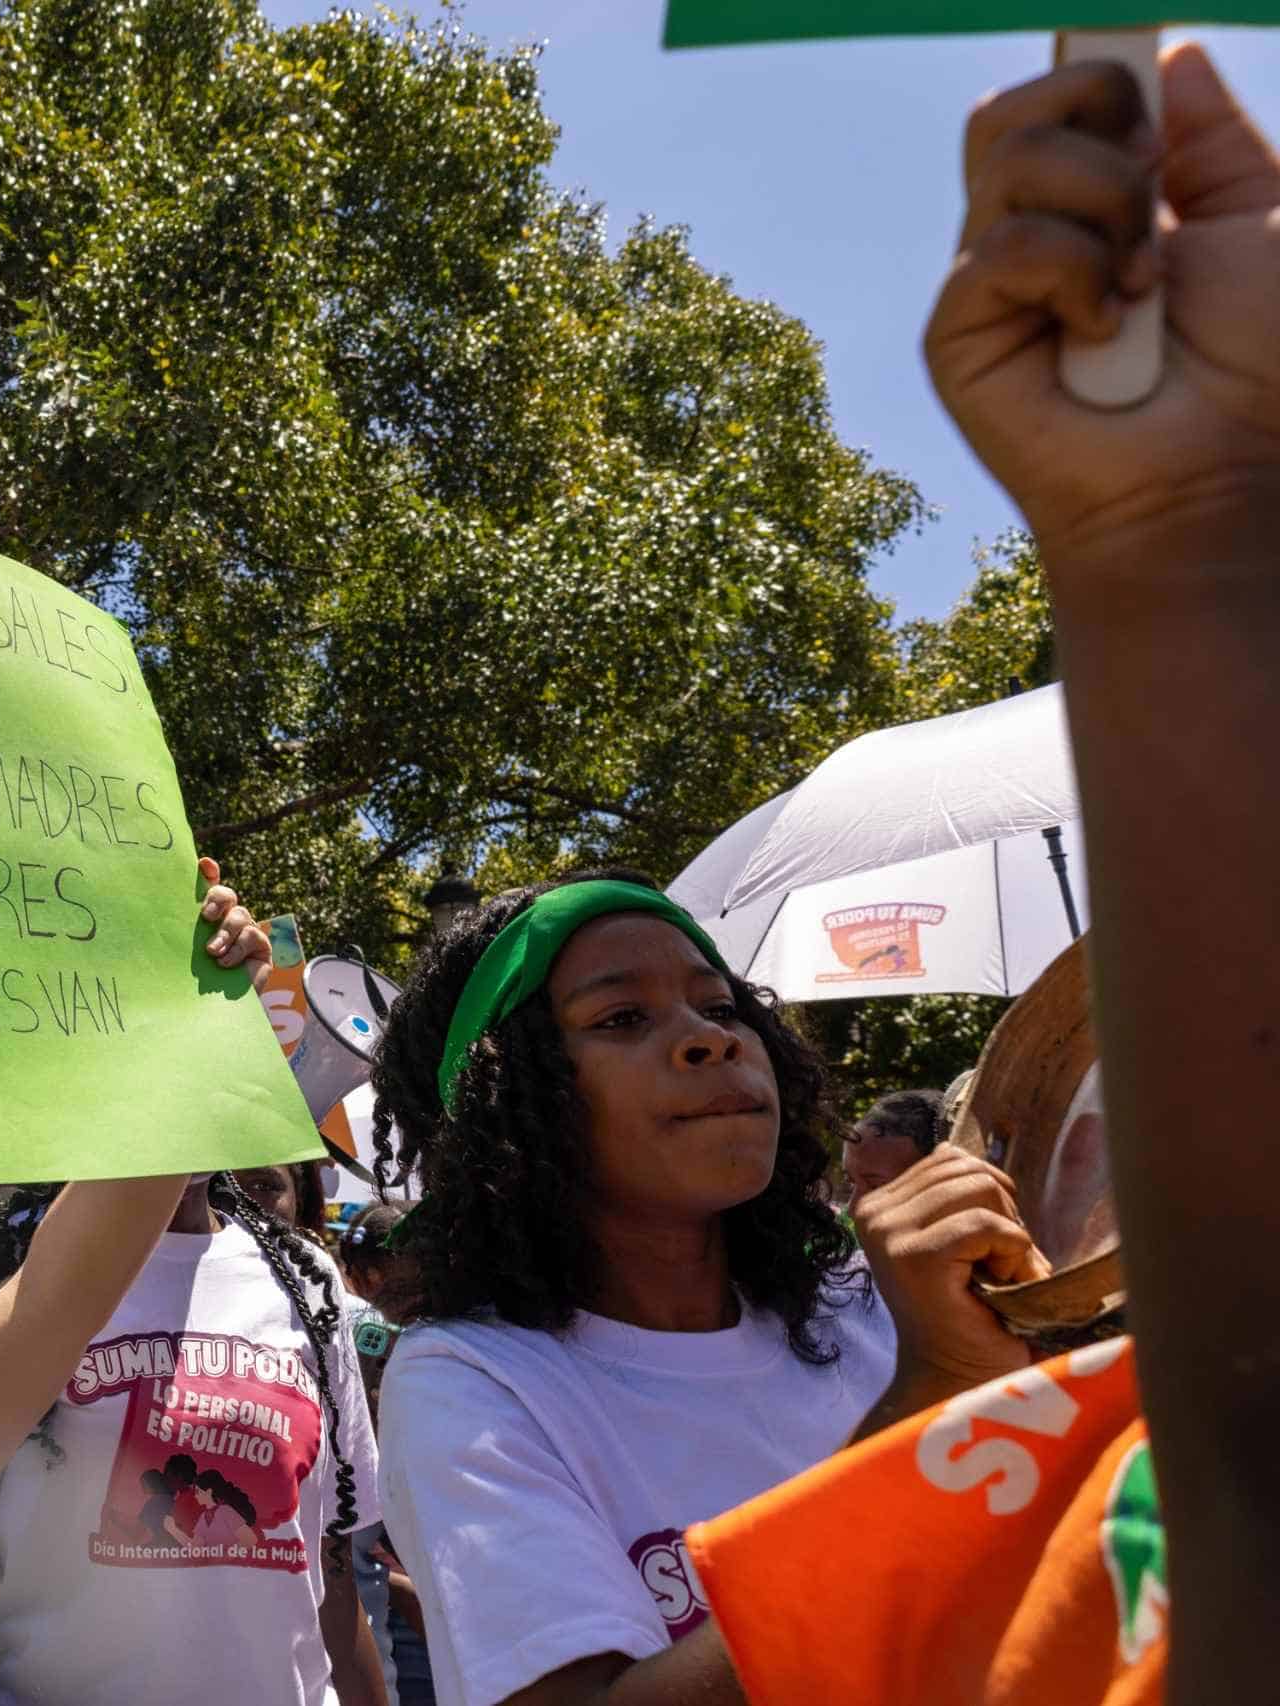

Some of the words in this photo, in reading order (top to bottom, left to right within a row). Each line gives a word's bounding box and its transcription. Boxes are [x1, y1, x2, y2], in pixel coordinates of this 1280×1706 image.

[72, 1338, 177, 1396] SUMA
[178, 1337, 230, 1378] TU
[146, 1409, 176, 1444] ES
[177, 1421, 276, 1467] POLÍTICO
[152, 1379, 180, 1410] LO
[183, 1391, 294, 1444] PERSONAL
[93, 1540, 116, 1558] Día
[119, 1542, 225, 1561] Internacional
[227, 1543, 250, 1559] de
[252, 1543, 269, 1560] la
[271, 1546, 310, 1566] Muje
